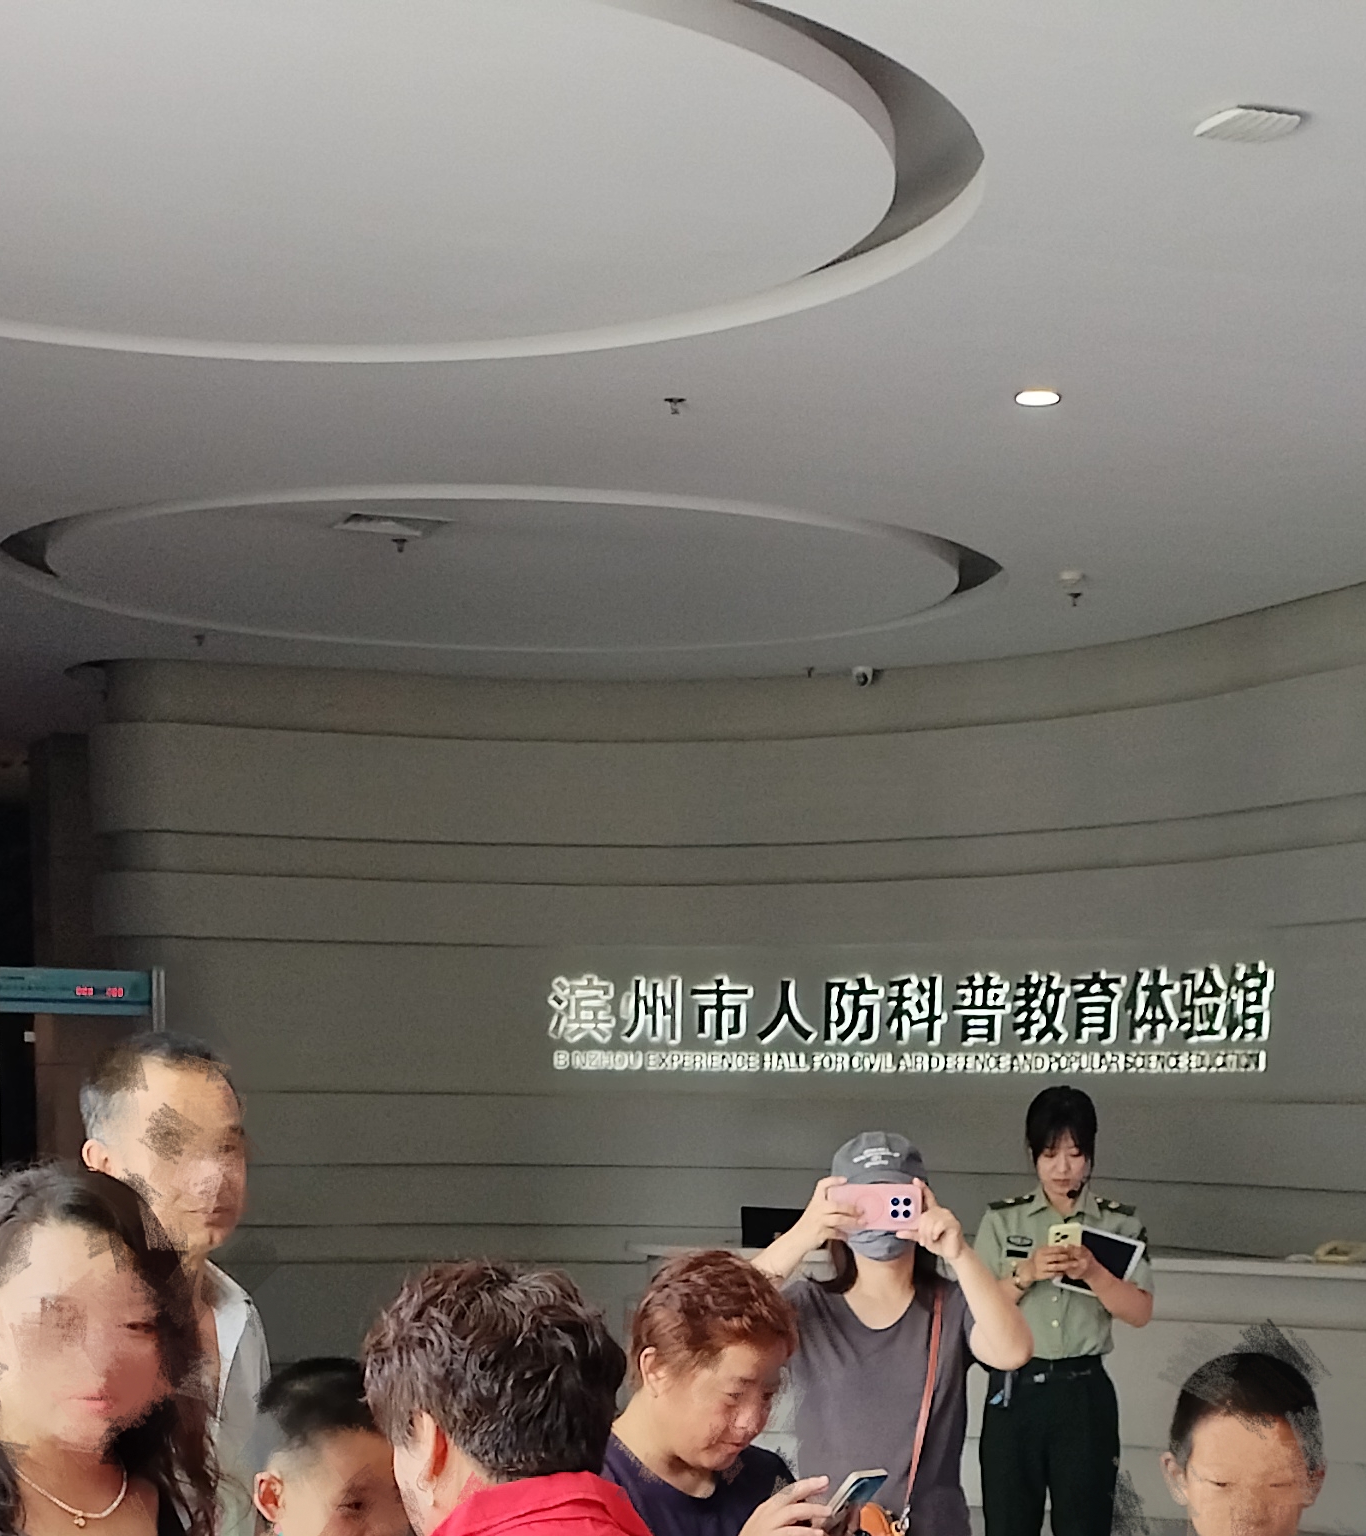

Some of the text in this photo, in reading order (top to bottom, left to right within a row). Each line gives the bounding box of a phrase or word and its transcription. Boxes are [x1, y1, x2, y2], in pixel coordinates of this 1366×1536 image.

[548, 963, 1275, 1045] 滨州市人防科普教育体验馆
[553, 1050, 642, 1070] BNZHOU
[645, 1051, 759, 1072] EXPERIENCE
[763, 1051, 810, 1072] HALL
[811, 1051, 849, 1072] FOR
